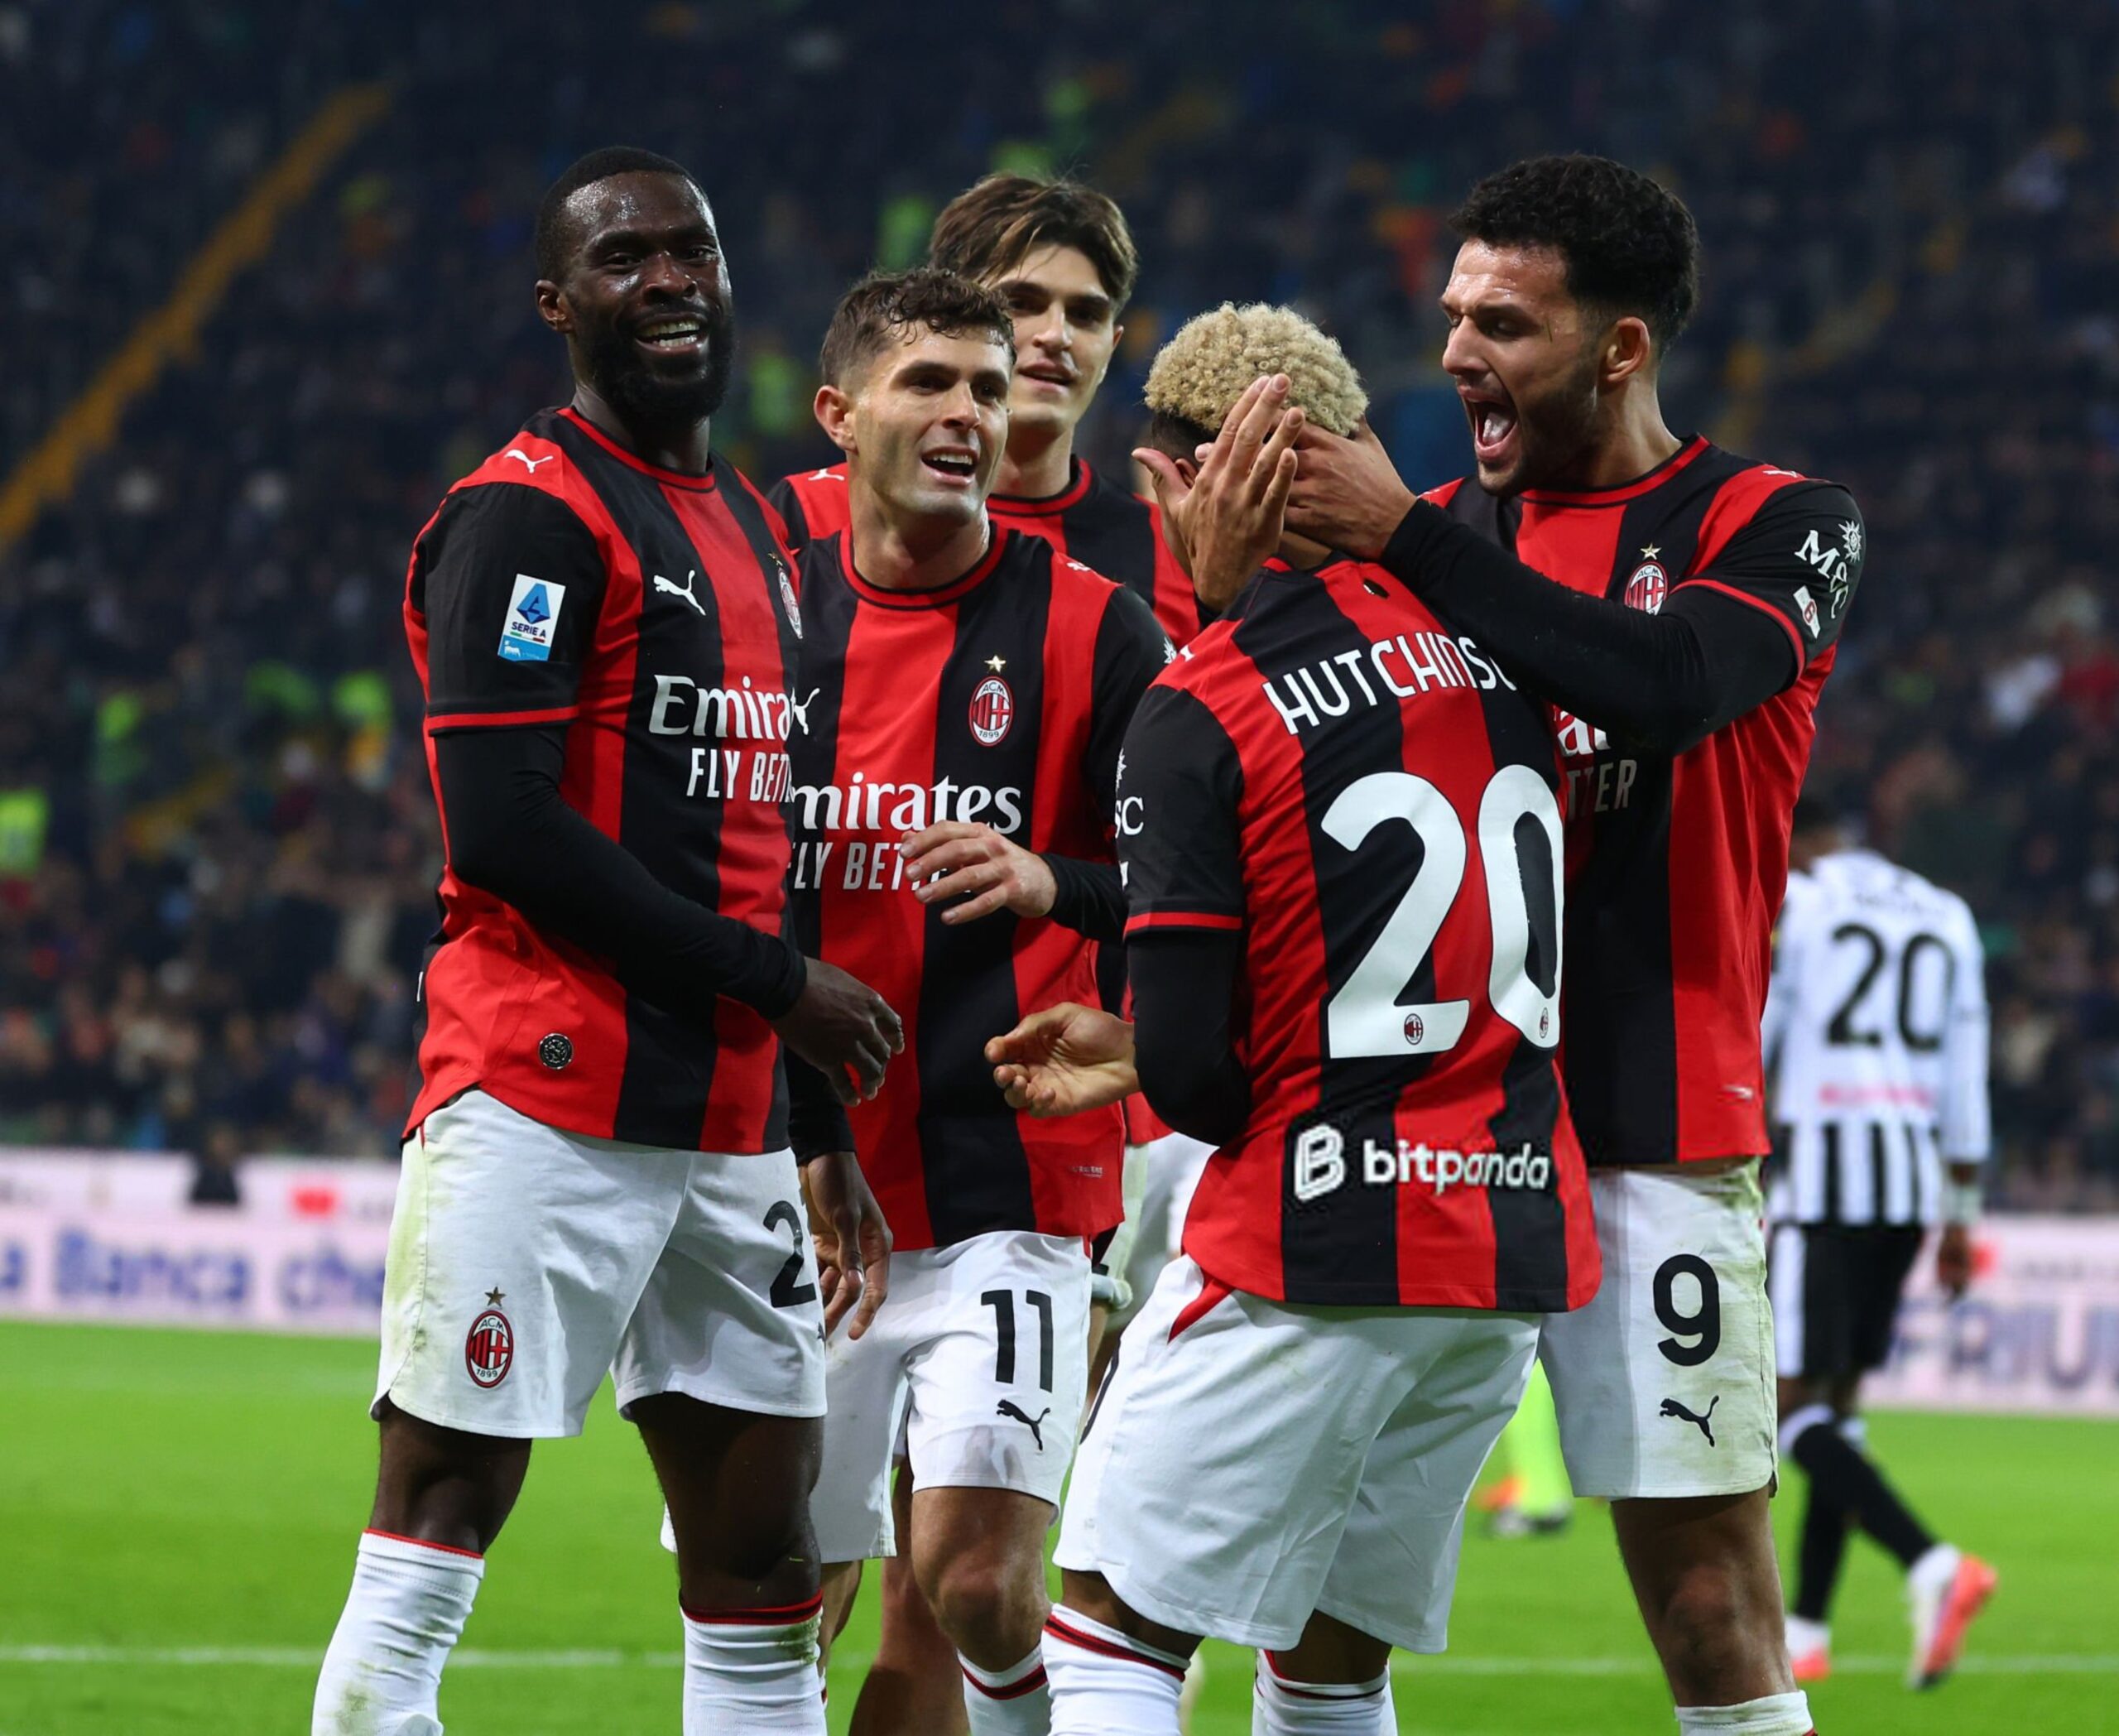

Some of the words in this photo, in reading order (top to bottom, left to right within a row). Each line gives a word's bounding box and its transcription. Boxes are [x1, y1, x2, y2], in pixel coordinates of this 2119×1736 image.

[512, 621, 539, 636] SERIE
[539, 629, 547, 638] A
[649, 675, 796, 741] Emira
[981, 681, 1006, 695] ACM
[1262, 632, 1517, 735] HUTCHINS
[979, 730, 1000, 738] 1899
[686, 748, 741, 799] FLY
[749, 752, 795, 803] BETT
[792, 772, 1022, 834] mirates
[788, 841, 834, 889] LY
[1321, 764, 1564, 1060] 20
[1825, 921, 1956, 1053] 20
[1363, 1139, 1550, 1195] bitpanda
[478, 1316, 505, 1332] ACM
[1653, 1253, 1720, 1367] 9
[980, 1288, 1054, 1394] 11
[476, 1368, 498, 1378] 1899
